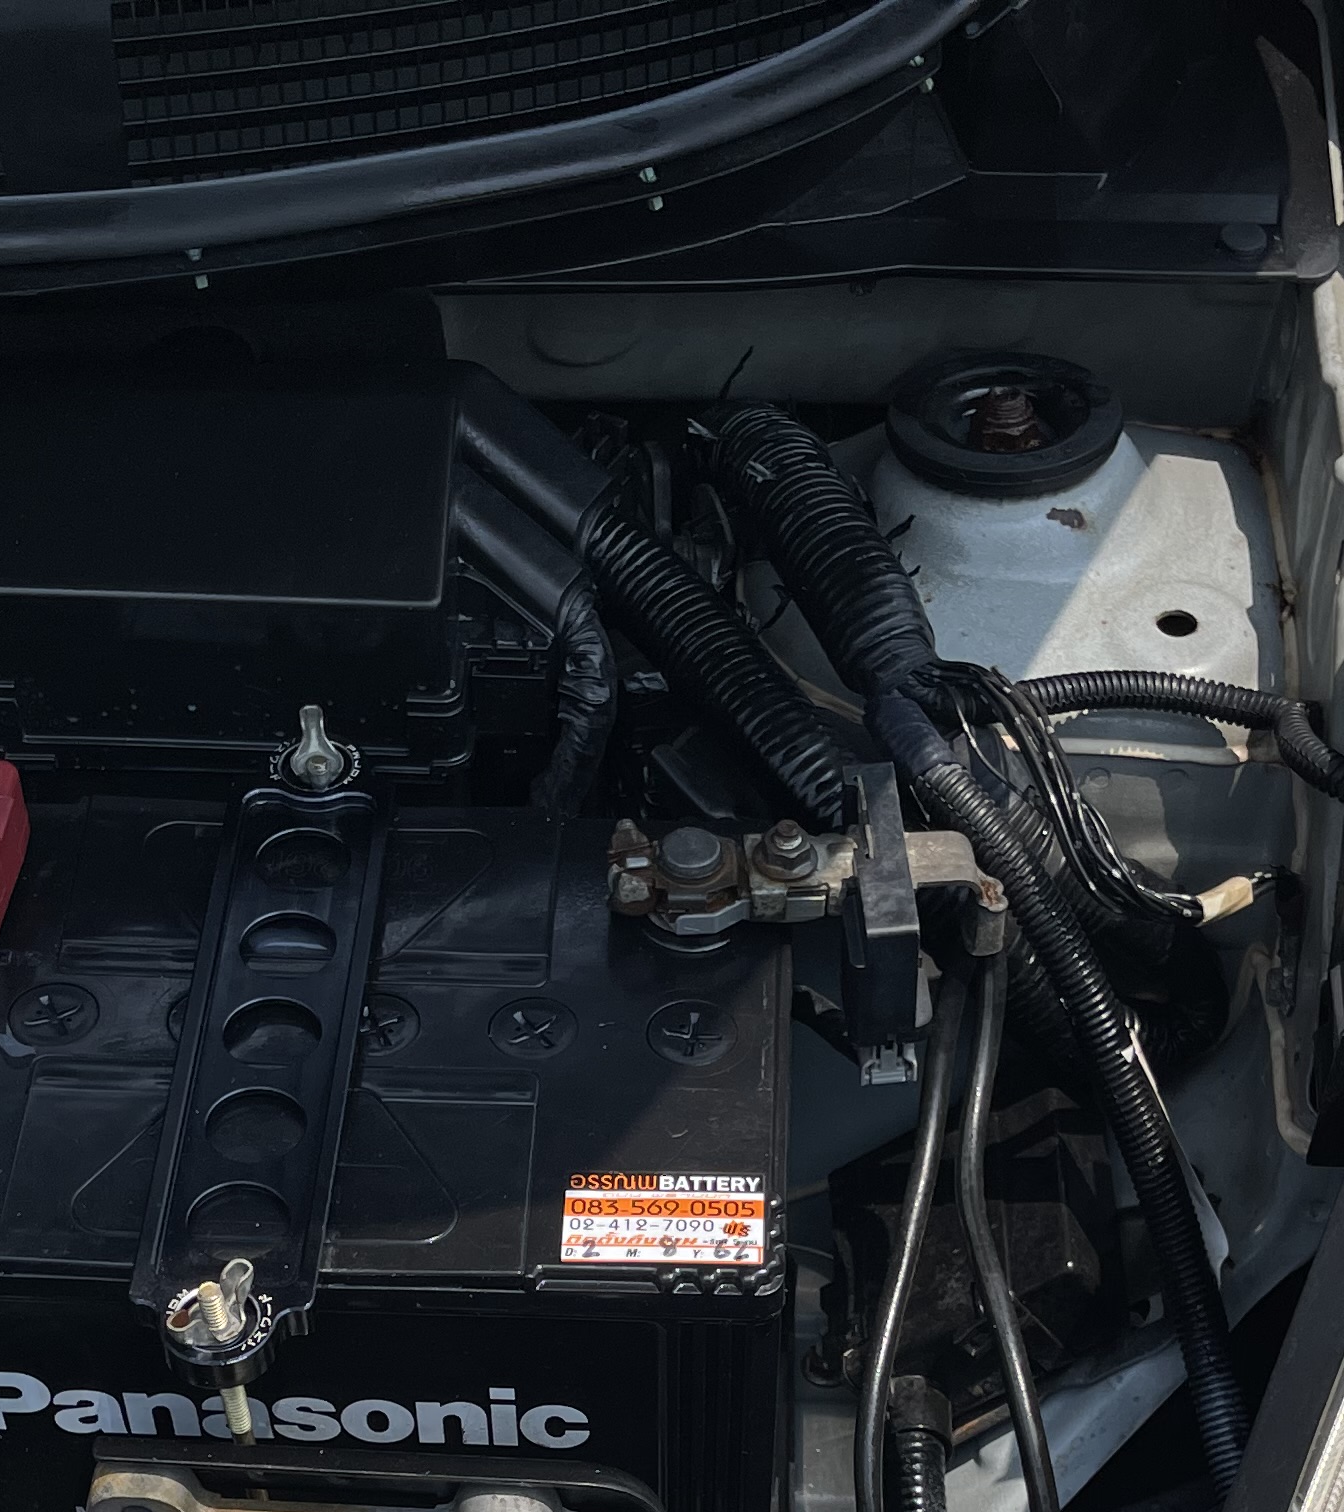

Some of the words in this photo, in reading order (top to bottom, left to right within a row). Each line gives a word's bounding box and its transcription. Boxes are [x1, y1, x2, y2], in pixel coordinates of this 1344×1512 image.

[659, 1174, 761, 1192] BATTERY
[570, 1198, 756, 1218] 083-569-0505
[569, 1217, 715, 1232] 02-412-7090
